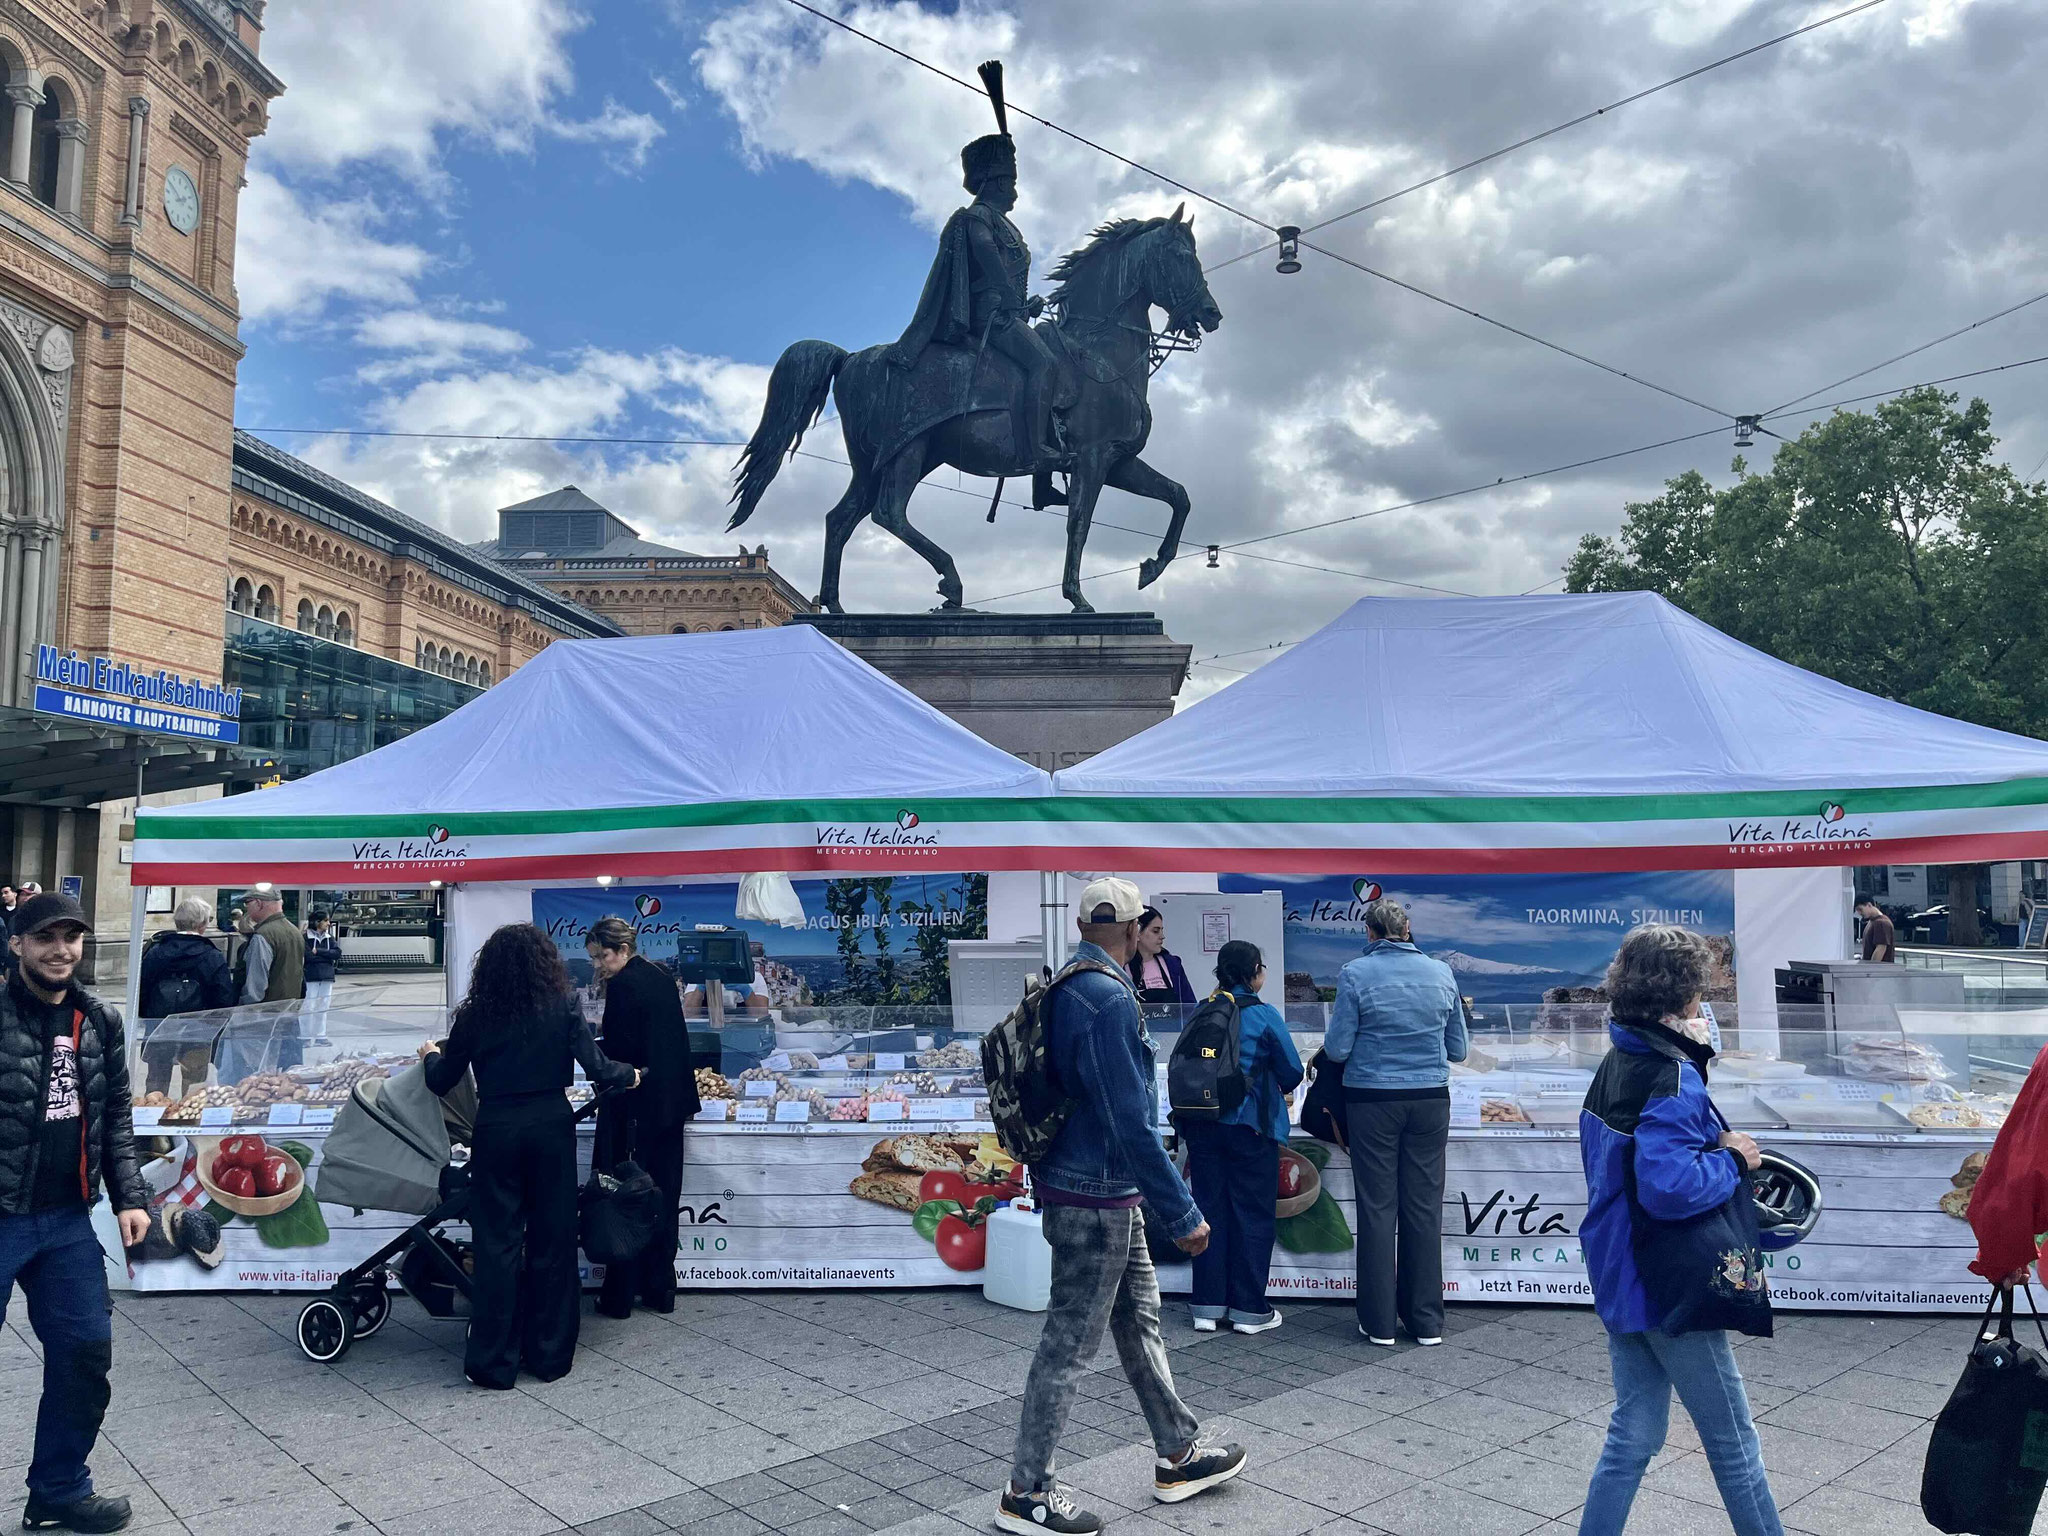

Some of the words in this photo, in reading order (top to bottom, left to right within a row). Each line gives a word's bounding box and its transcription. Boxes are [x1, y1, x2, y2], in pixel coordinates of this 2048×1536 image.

[37, 644, 90, 688] Mein
[93, 656, 242, 717] Einkaufsbahnhof
[64, 695, 131, 723] HANNOVER
[134, 709, 221, 737] HAUPTBAHNHOF
[816, 826, 857, 845] Vita
[862, 826, 938, 845] Italiana
[1728, 822, 1775, 842] Vita
[1782, 820, 1871, 841] Italiana
[353, 842, 392, 860] Vita
[398, 841, 467, 858] Italiana
[816, 848, 872, 856] MERCATO
[880, 848, 938, 856] ITALIANO
[1729, 845, 1794, 854] MERCATO
[1803, 842, 1871, 852] ITALIANO
[353, 862, 405, 870] MERCATO
[803, 914, 850, 930] AGUS
[856, 914, 894, 929] IBLA,
[900, 911, 963, 927] SIZILIEN
[1526, 908, 1625, 926] TAORMINA,
[1631, 909, 1703, 925] SIZILIEN
[545, 917, 588, 937] Vita
[1284, 927, 1322, 935] CATO
[1333, 927, 1367, 935] ITAL
[641, 939, 672, 947] LIAN
[1461, 1189, 1571, 1235] Vita
[1463, 1247, 1586, 1263] MERCAT
[676, 1267, 895, 1280] w.facebook.com/vitaitalianaevents
[1480, 1279, 1512, 1292] Jetzt
[1517, 1280, 1540, 1293] Fan
[1546, 1281, 1593, 1294] werde
[1766, 1286, 1990, 1305] acebook.com/vitaitalianaevents
